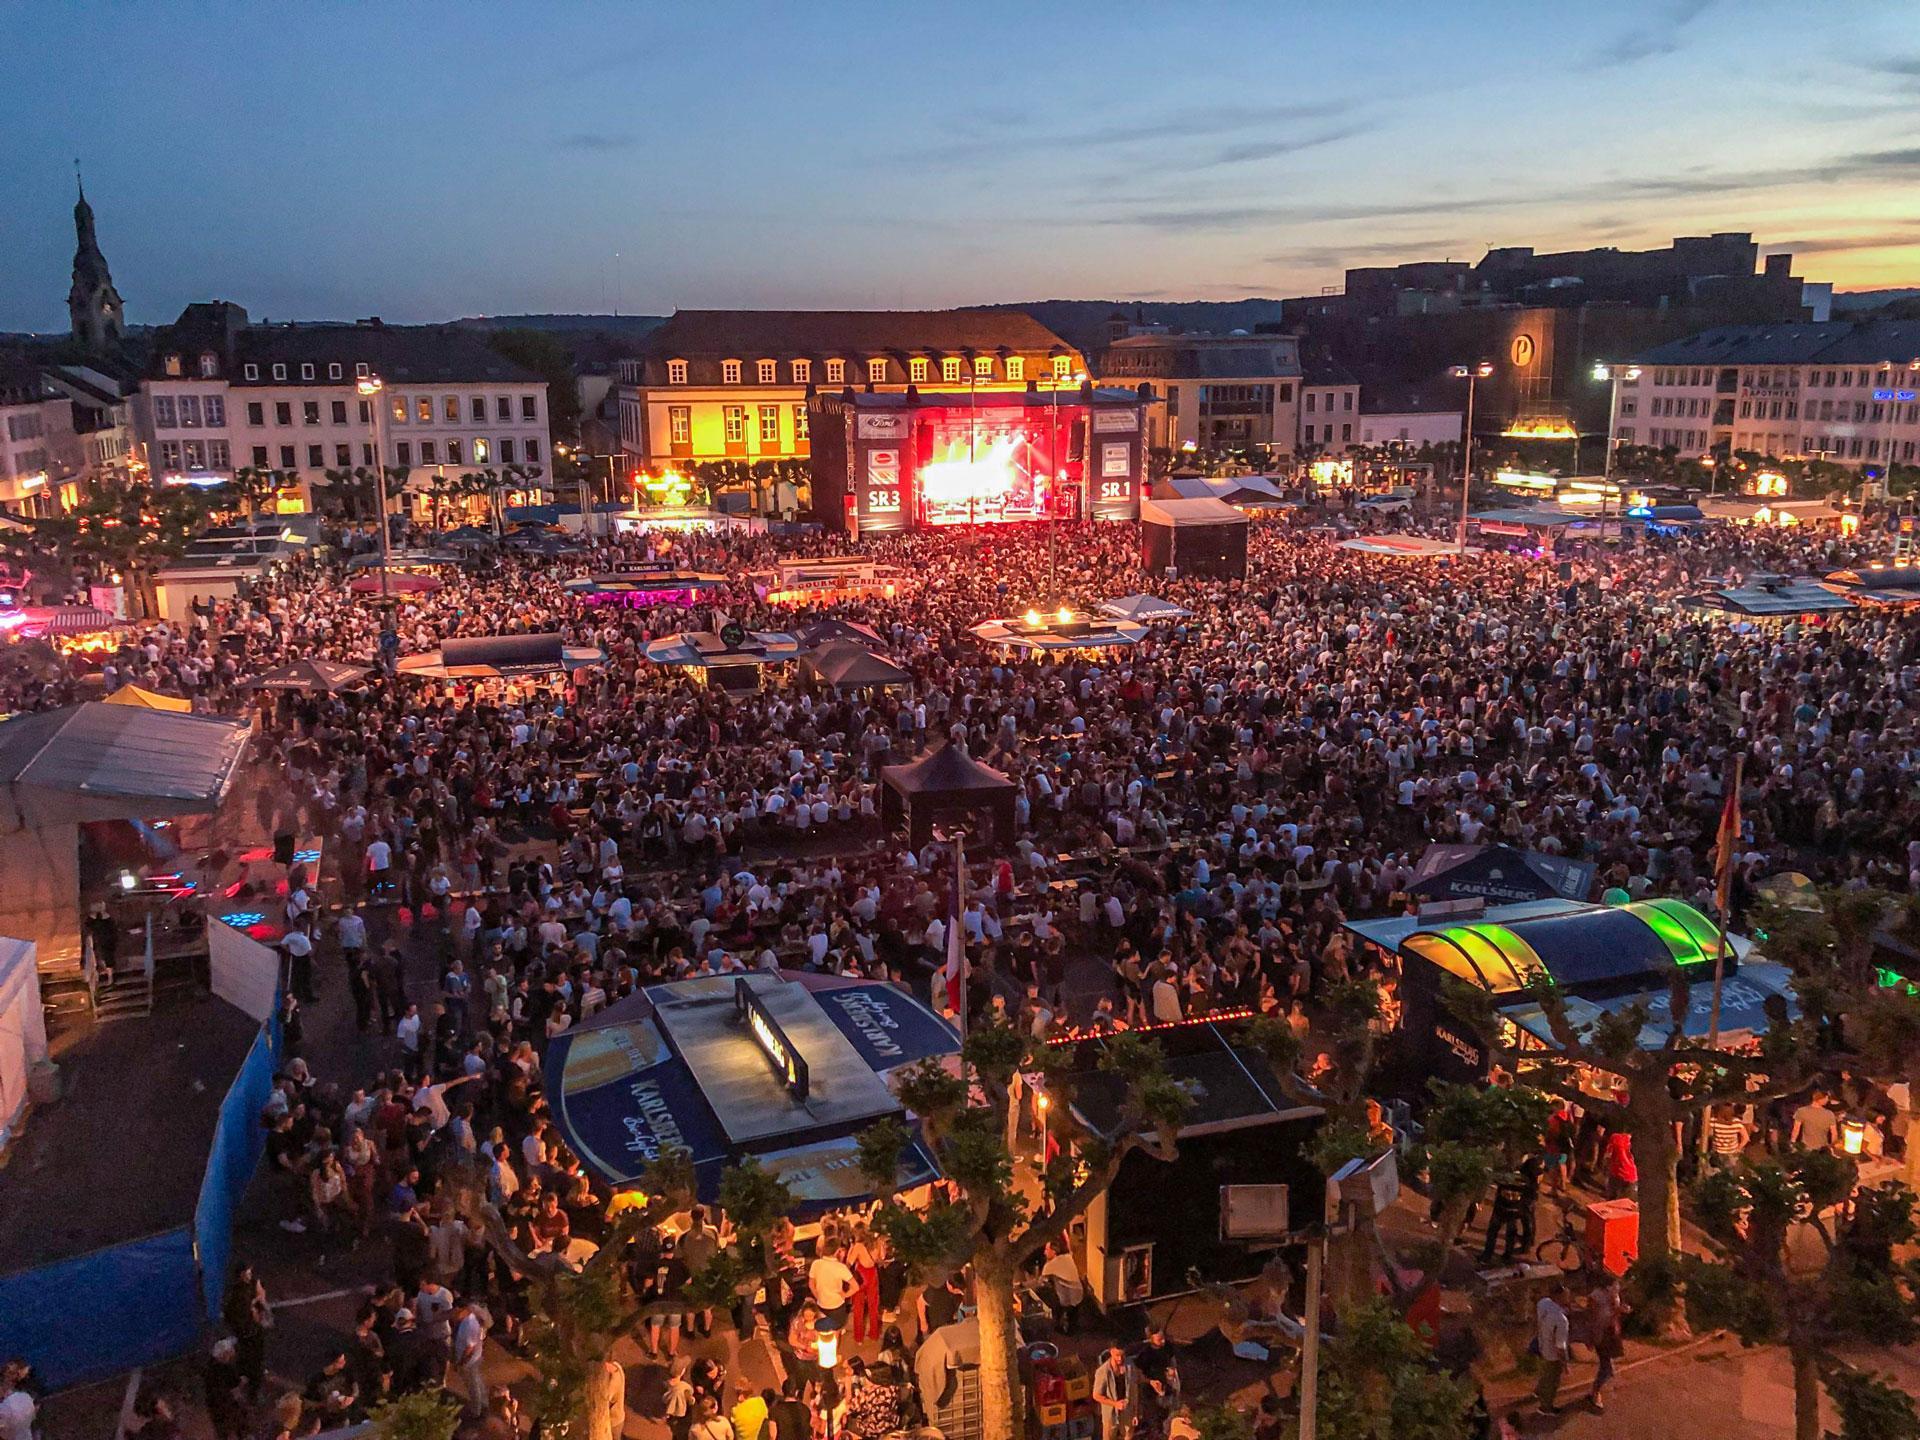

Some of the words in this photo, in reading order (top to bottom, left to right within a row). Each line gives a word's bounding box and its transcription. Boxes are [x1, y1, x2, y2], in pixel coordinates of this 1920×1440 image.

[868, 490, 889, 506] SR
[891, 490, 901, 506] 3
[1101, 482, 1120, 497] SR
[1124, 482, 1131, 496] 1
[1450, 881, 1537, 900] KARLSBERG
[832, 996, 903, 1057] KARLSBERG
